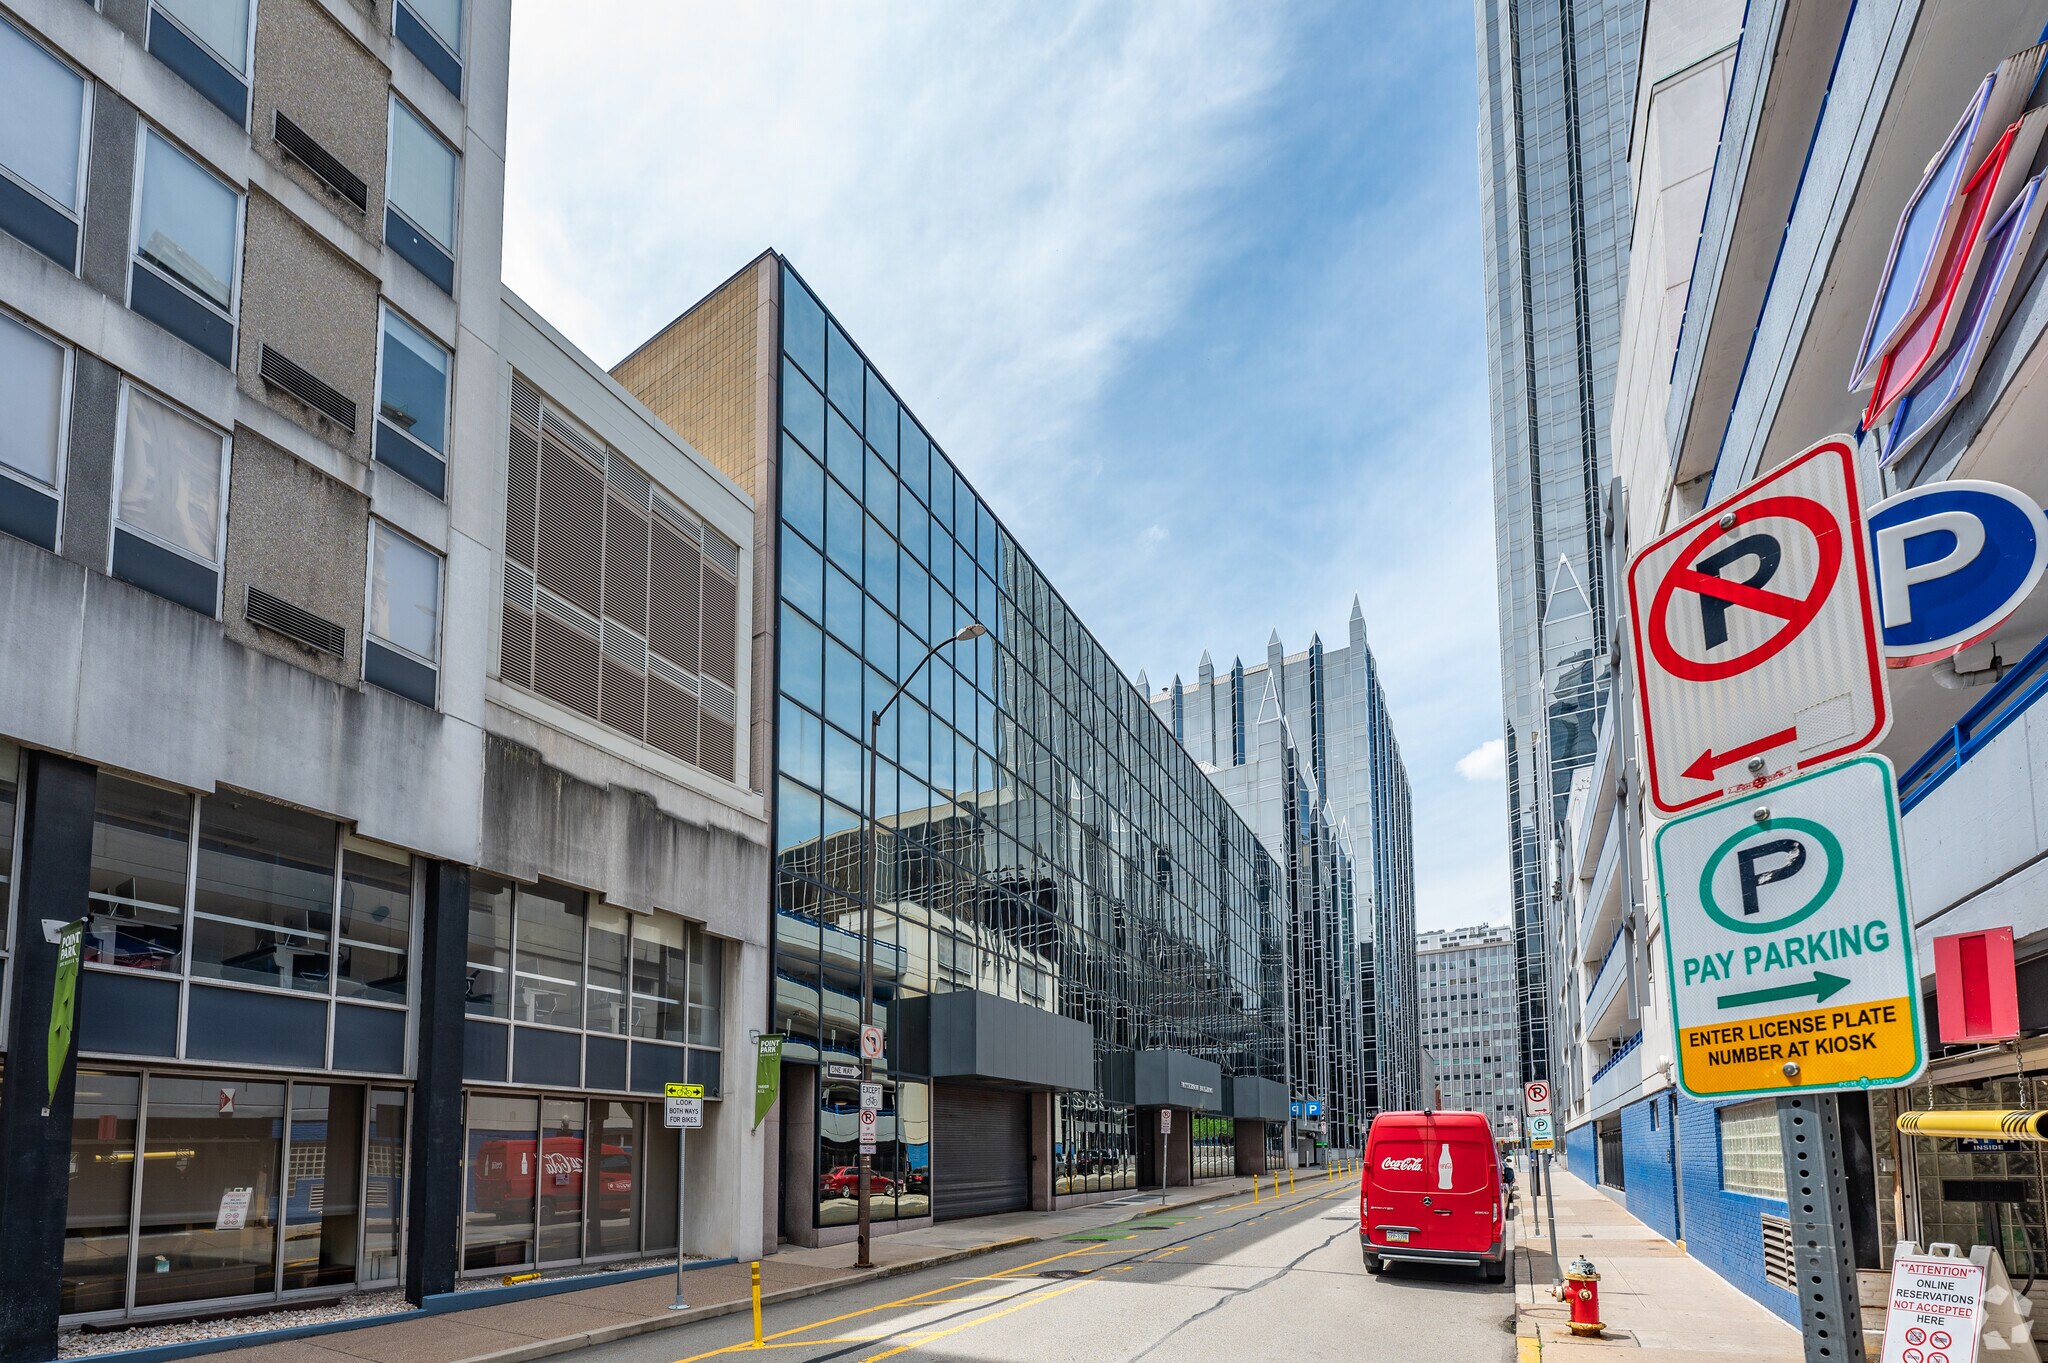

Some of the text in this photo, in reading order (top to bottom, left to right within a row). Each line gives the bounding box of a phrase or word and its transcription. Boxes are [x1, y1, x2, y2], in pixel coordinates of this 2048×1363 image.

[1877, 511, 1986, 629] P
[1696, 533, 1781, 651] P
[1737, 838, 1806, 916] P
[62, 931, 80, 948] POINT
[60, 944, 77, 960] PARK
[1683, 920, 1890, 986] PAY PARKING
[1689, 1005, 1897, 1047] ENTER LICENSE PLATE
[1708, 1032, 1877, 1066] NUMBER AT KIOSK
[830, 1065, 853, 1075] ONE WAY
[863, 1086, 880, 1094] EXCEPT
[1309, 1105, 1317, 1114] P
[1538, 1121, 1544, 1129] P
[1381, 1156, 1424, 1171] Coca-Cola
[1916, 1279, 1955, 1290] ONLINE
[1896, 1289, 1974, 1305] RESERVATIONS
[1893, 1300, 1973, 1317] NOT ACCEPTED
[1916, 1314, 1945, 1325] HERE
